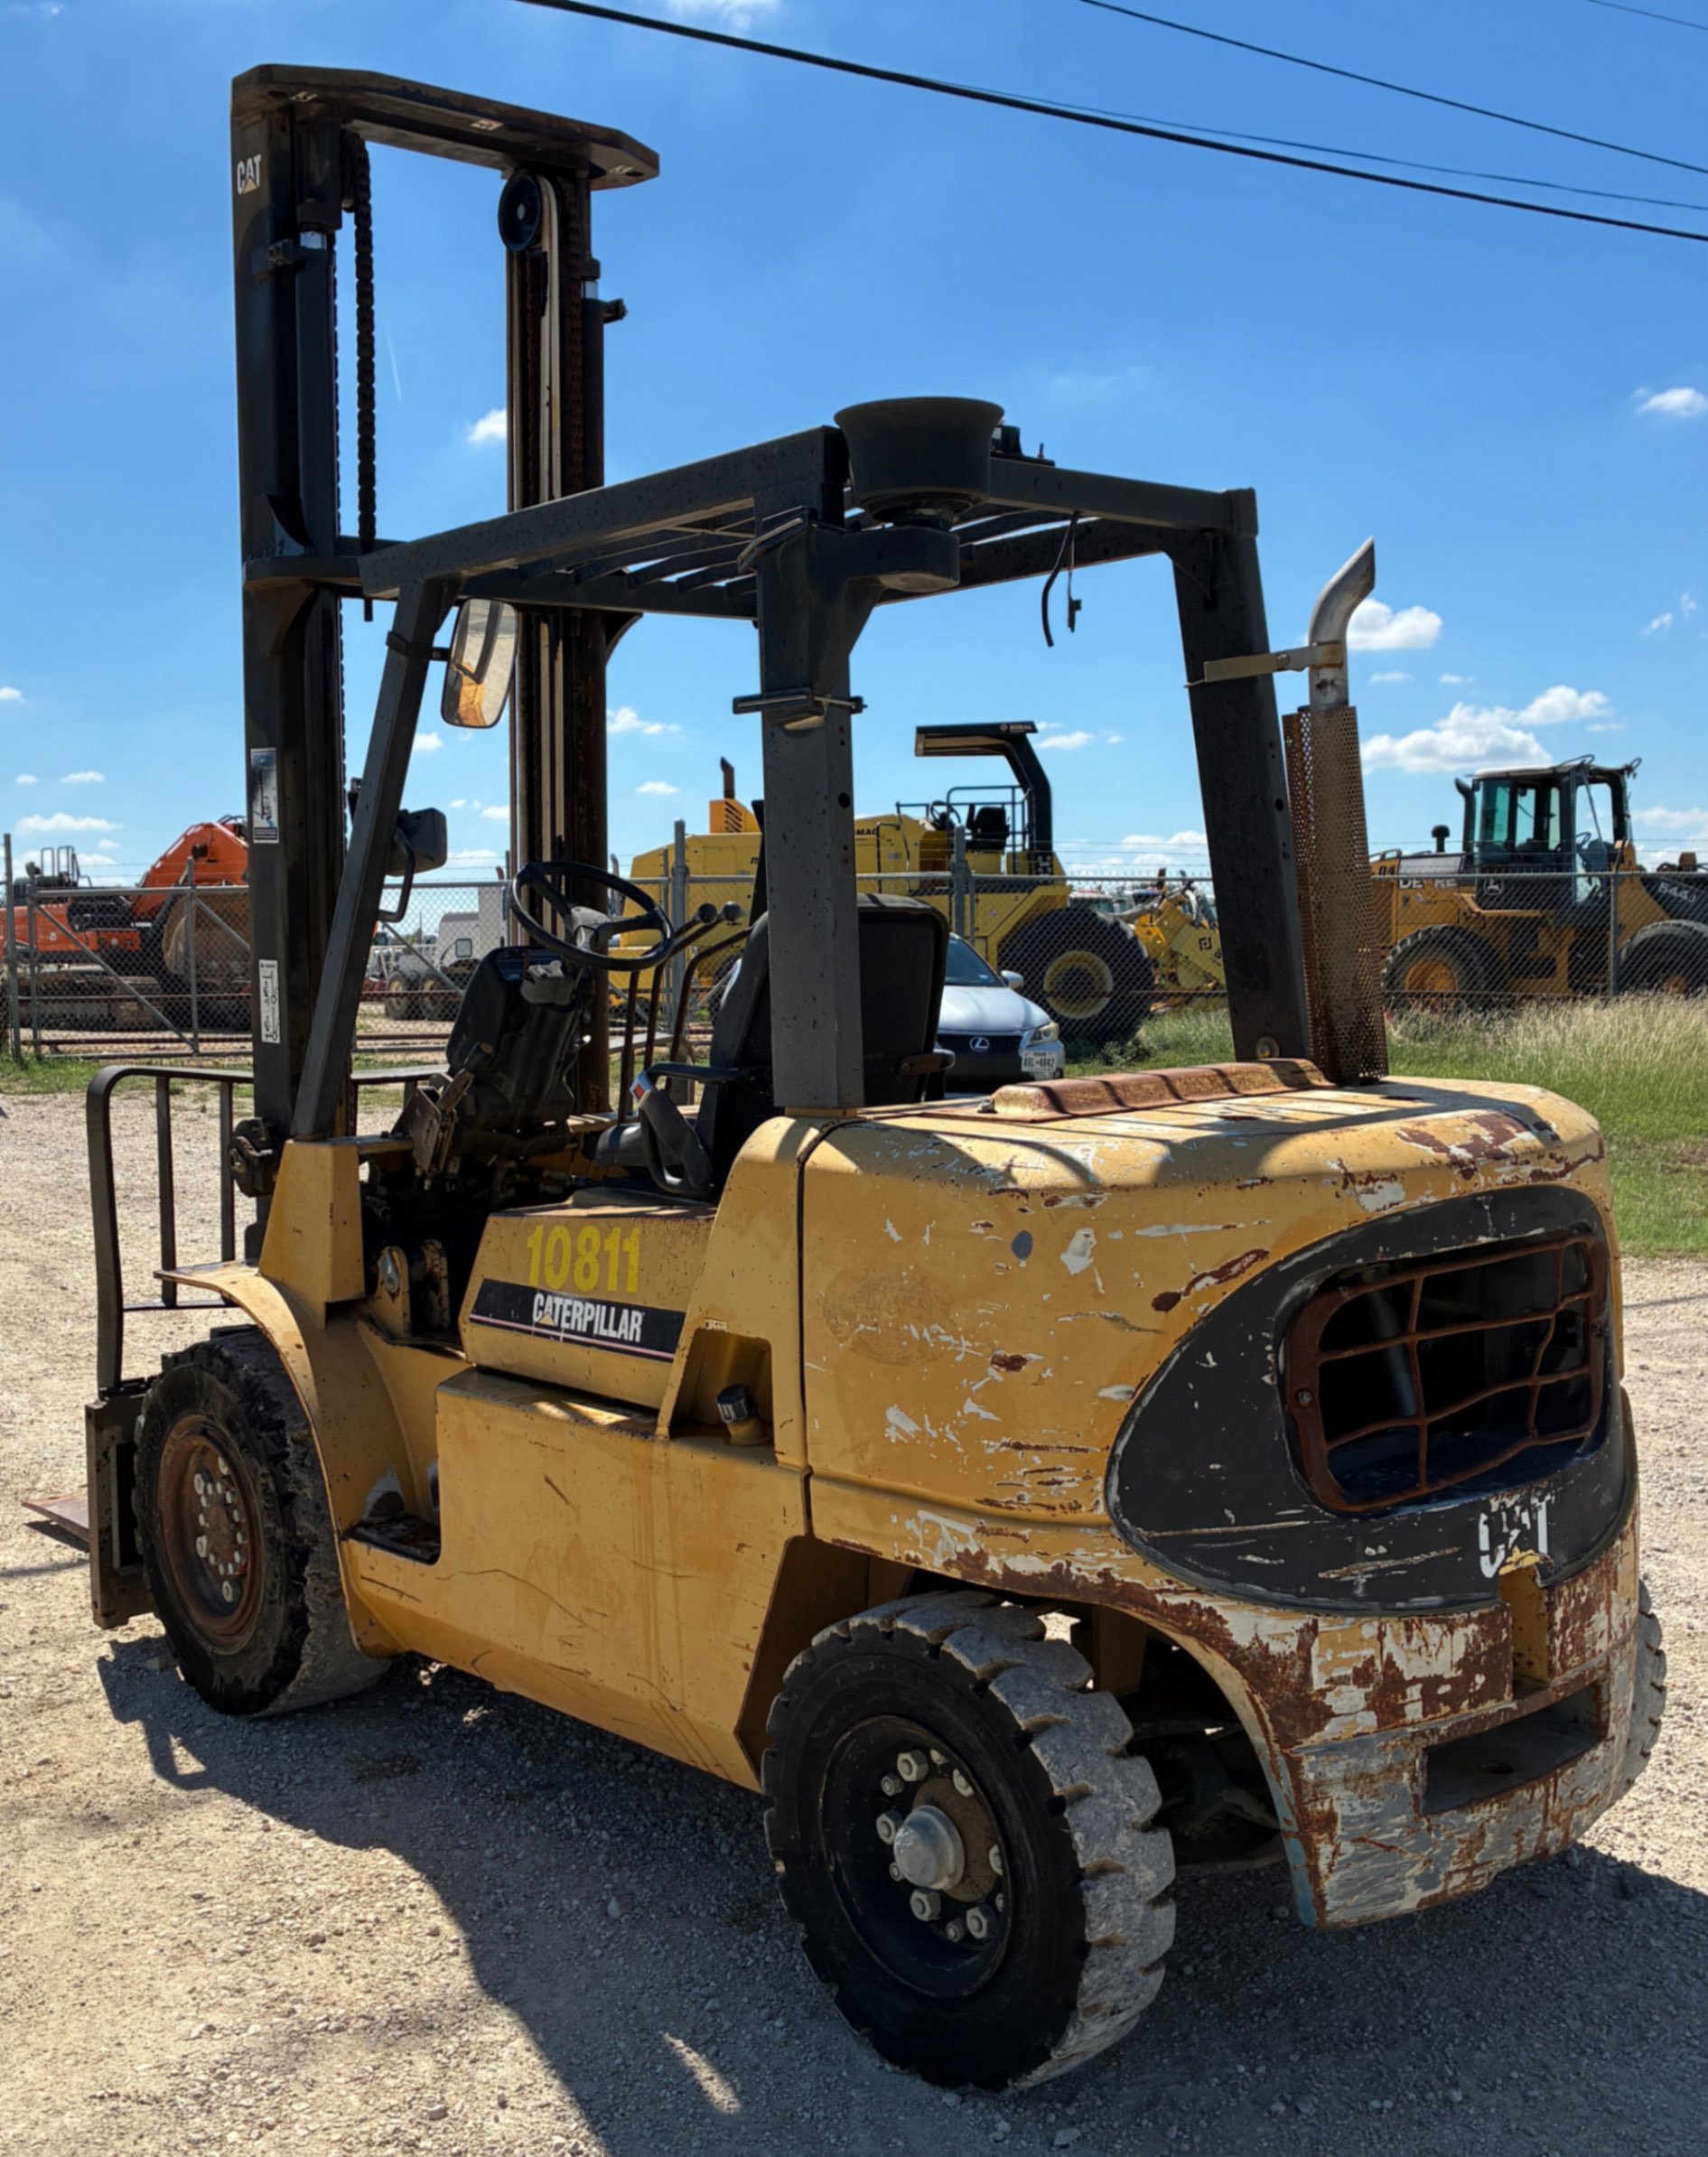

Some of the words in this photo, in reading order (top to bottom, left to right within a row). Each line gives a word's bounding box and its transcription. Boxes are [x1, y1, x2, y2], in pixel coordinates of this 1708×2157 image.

[237, 154, 262, 195] CAT
[527, 1224, 641, 1293] 10811
[532, 1293, 645, 1343] CATERPILLAR
